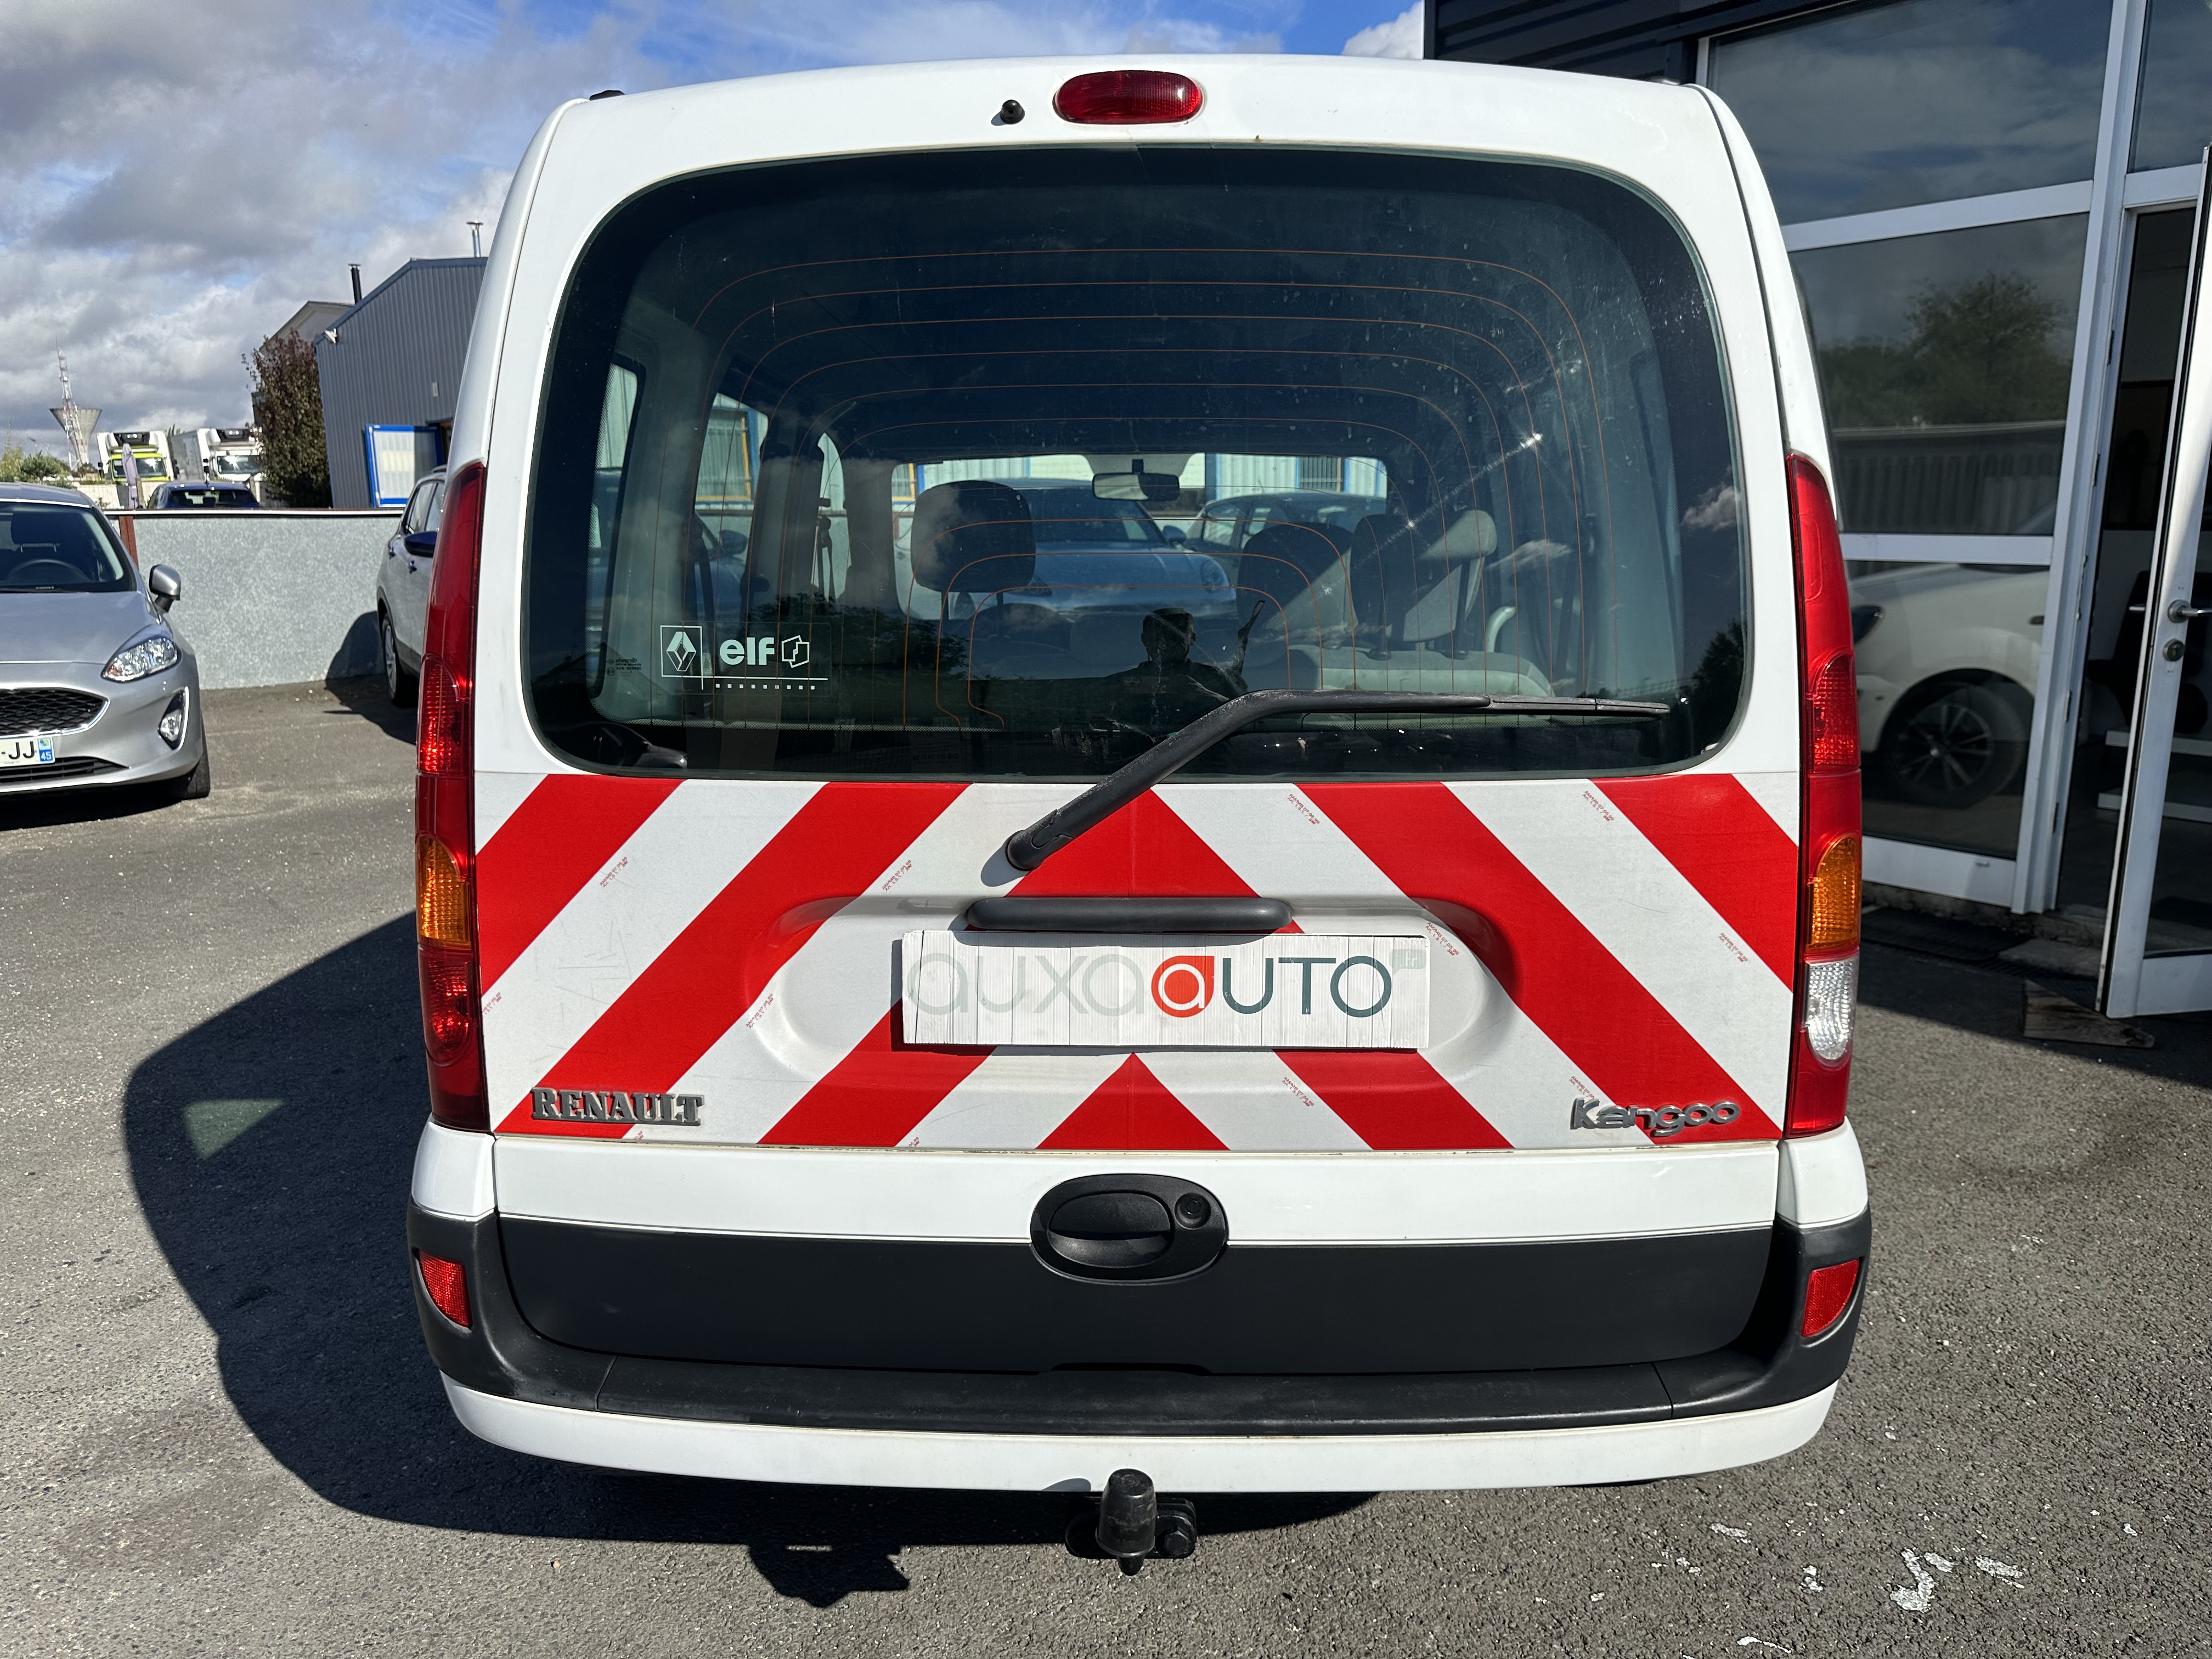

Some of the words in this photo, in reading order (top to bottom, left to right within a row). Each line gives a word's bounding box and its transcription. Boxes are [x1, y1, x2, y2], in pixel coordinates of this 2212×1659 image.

[719, 636, 775, 666] elf
[41, 751, 52, 761] 45
[531, 1087, 705, 1127] RENAULT
[1570, 1097, 1741, 1137] Kangoo
